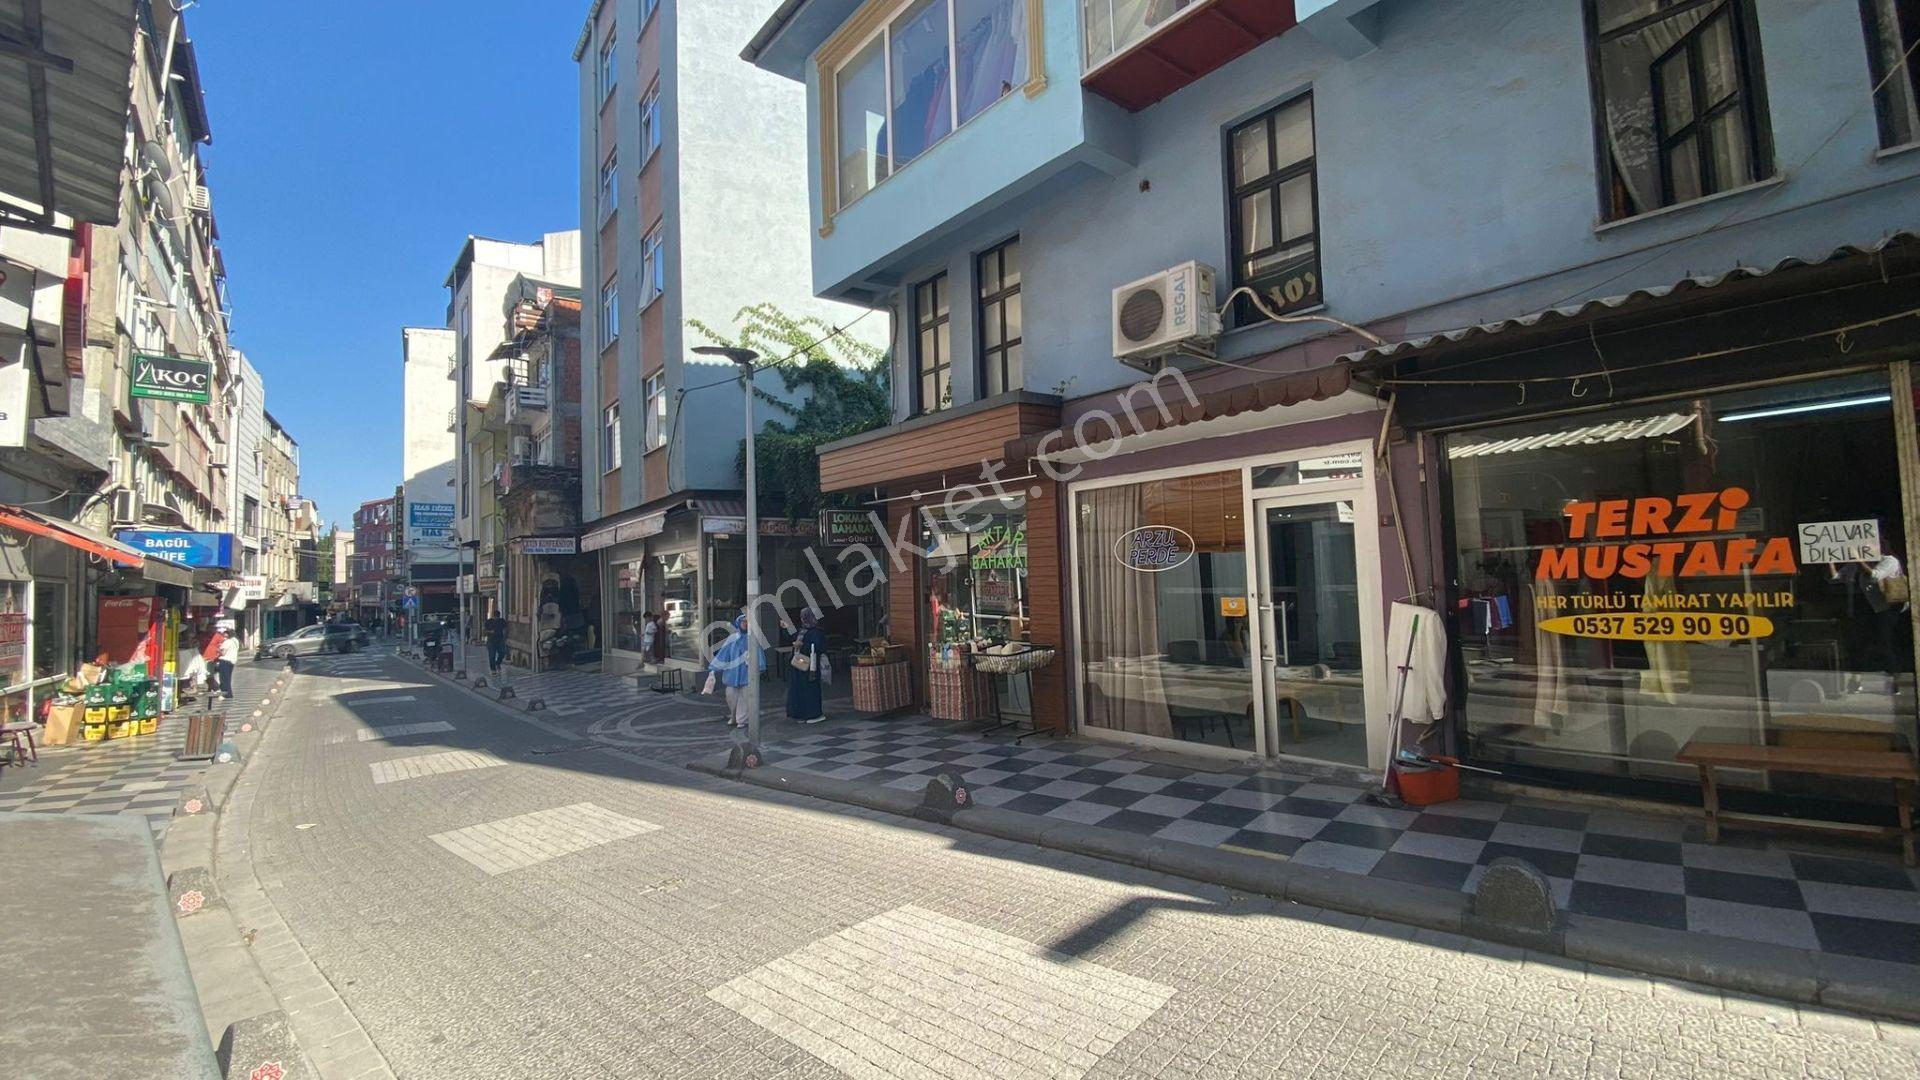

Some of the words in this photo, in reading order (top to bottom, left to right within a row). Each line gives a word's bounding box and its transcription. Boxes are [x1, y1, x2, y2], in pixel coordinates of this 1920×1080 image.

[1174, 272, 1186, 326] REGAL
[975, 525, 1025, 552] AKTAR
[1131, 529, 1177, 548] ARZU
[1130, 546, 1179, 565] PERDE
[1536, 537, 1798, 581] MUSTAFA
[1536, 595, 1568, 610] HER
[1571, 592, 1627, 610] TÜRLÜ
[1631, 592, 1711, 609] TAMİRAT
[1717, 591, 1795, 608] YAPILIR
[1573, 616, 1625, 635] 0537
[1633, 616, 1675, 635] 529
[1682, 616, 1712, 635] 90
[1720, 616, 1751, 635] 90
